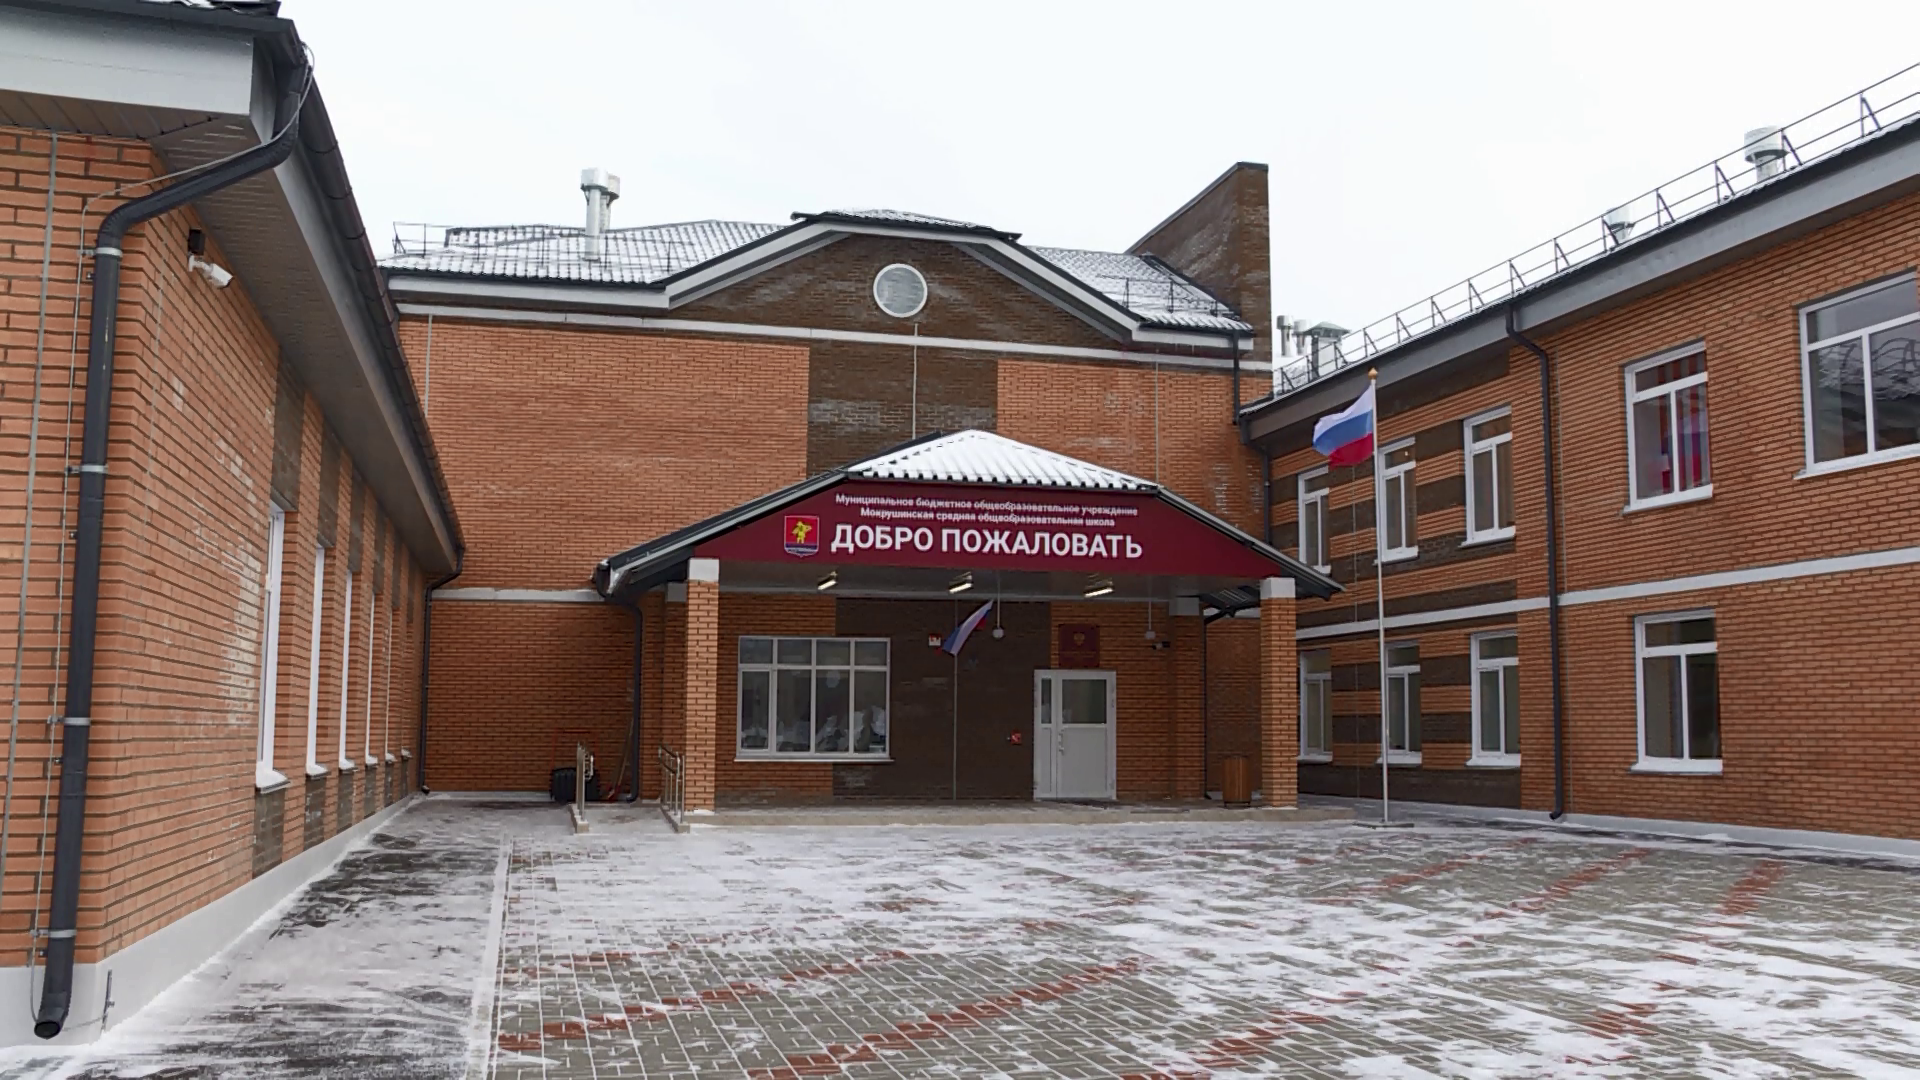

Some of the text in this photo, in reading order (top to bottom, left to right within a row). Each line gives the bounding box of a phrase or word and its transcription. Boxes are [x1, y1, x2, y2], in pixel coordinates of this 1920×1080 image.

[835, 493, 1138, 516] Муниципальное бюджетное общеобразовательное учреждение
[860, 507, 1115, 527] Мокрушинская средняя общеобразовательная школа
[831, 524, 1144, 559] ДОБРО ПОЖАЛОВАТЬ
